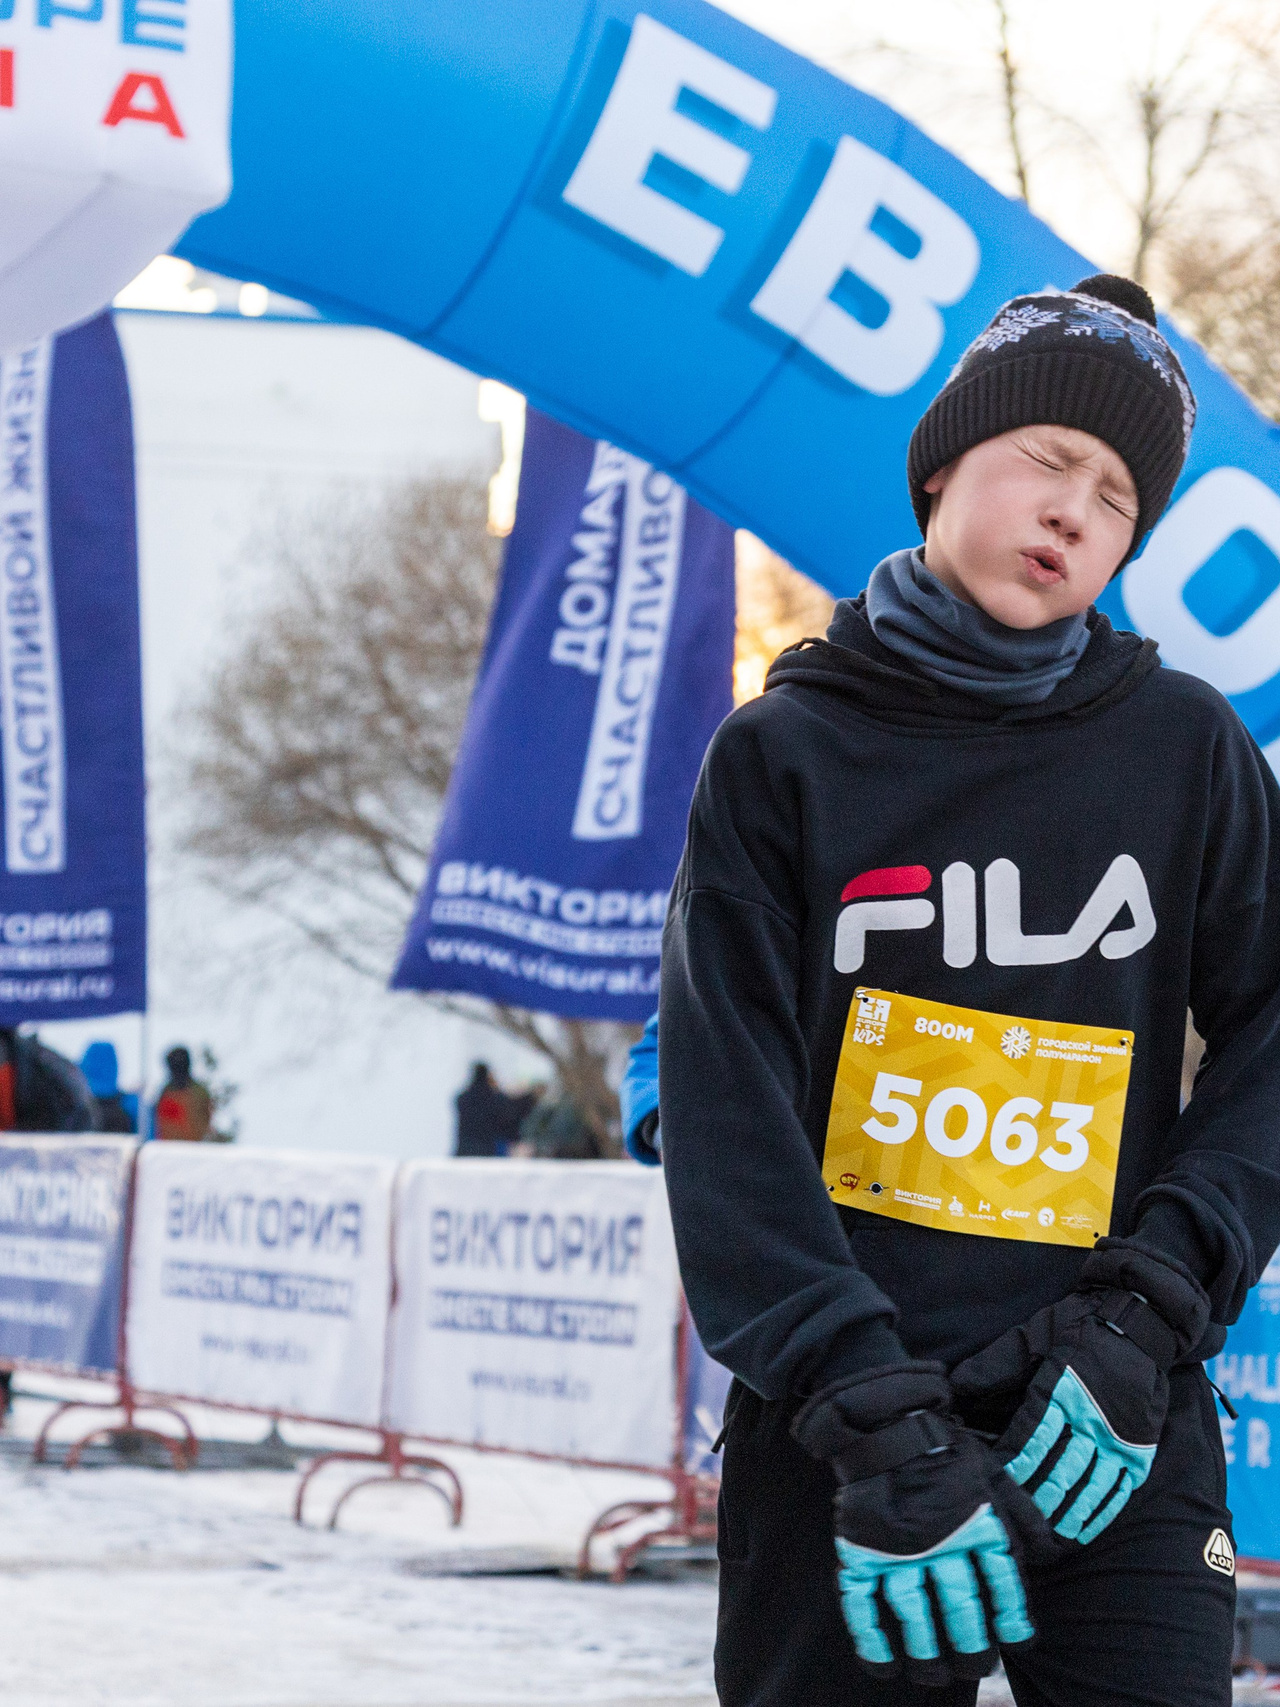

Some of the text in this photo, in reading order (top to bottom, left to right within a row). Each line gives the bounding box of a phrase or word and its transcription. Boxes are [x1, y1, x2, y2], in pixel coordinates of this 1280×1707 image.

[833, 853, 1157, 974] FILA
[1035, 1048, 1102, 1064] ПОЛУМАРАФОН
[1037, 1037, 1127, 1056] ГОРОДСКОЙ ЗИМНИЙ
[860, 1071, 1095, 1173] 5063
[167, 1185, 363, 1256] ВИКТОРИЯ
[895, 1188, 942, 1205] ВИКТОРИЯ
[431, 1207, 644, 1276] ВИКТОРИЯ
